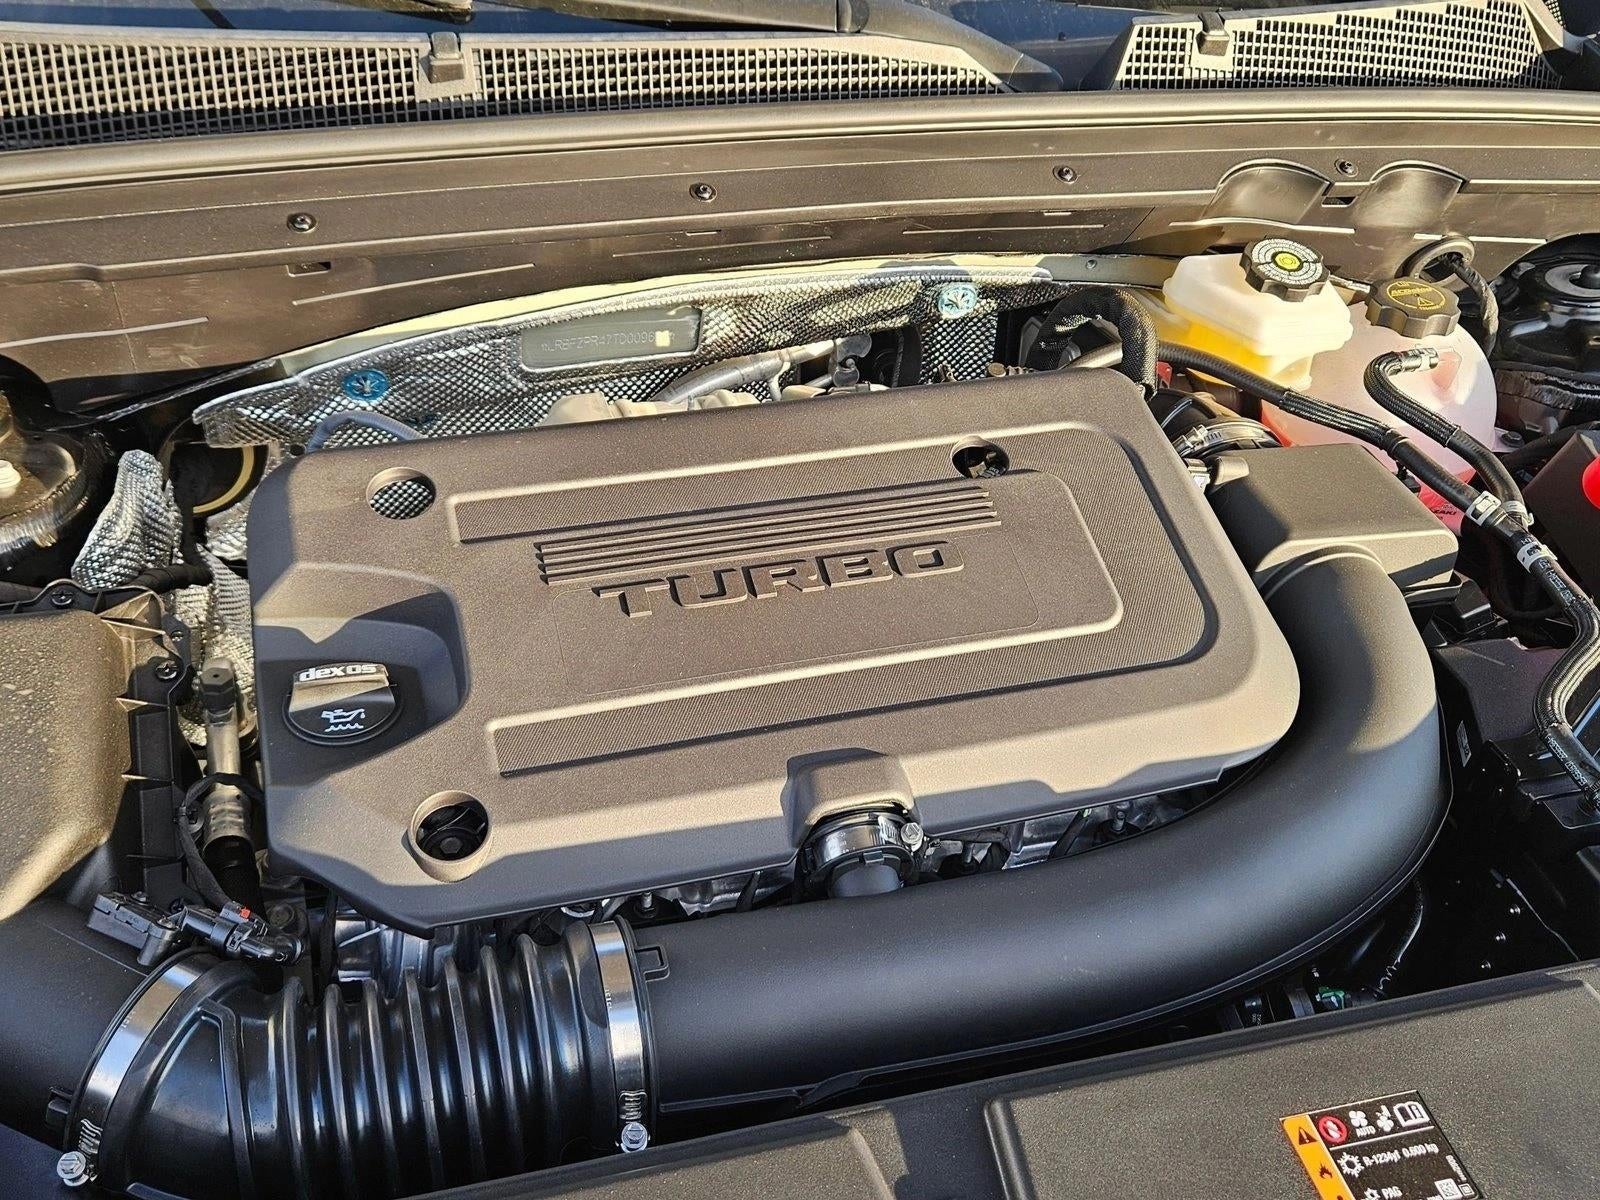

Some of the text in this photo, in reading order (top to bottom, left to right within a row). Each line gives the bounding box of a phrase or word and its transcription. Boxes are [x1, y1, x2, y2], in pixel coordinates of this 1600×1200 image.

[591, 540, 964, 618] TURBO
[299, 665, 377, 681] dexos
[1356, 1126, 1376, 1137] AUTO
[1381, 1186, 1402, 1200] PAG
